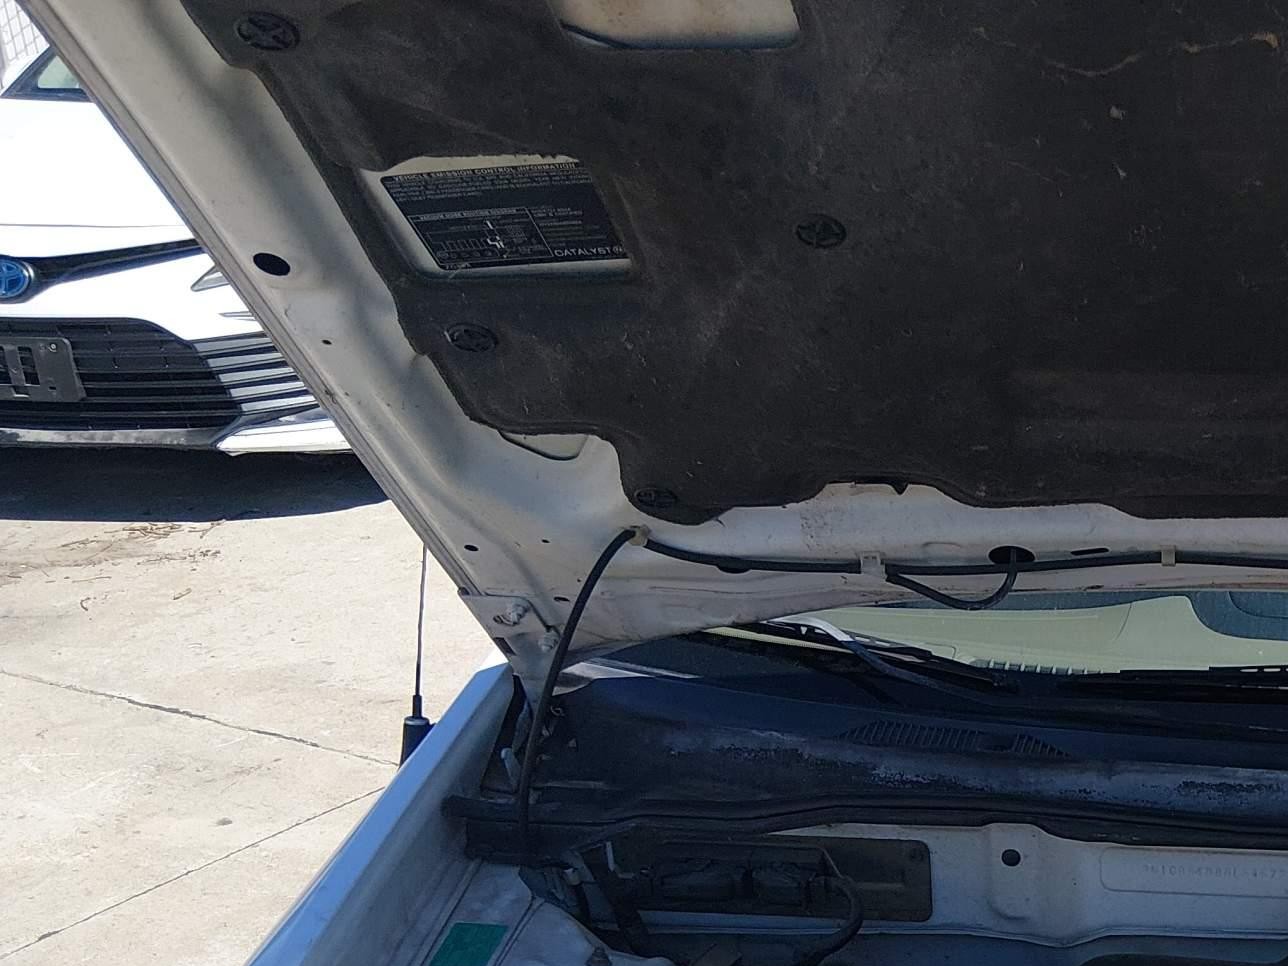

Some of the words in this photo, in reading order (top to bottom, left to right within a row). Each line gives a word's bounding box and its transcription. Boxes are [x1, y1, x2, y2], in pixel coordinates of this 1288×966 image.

[475, 167, 515, 175] CONTROL
[517, 163, 576, 172] INFORMATION
[554, 246, 612, 257] CATALYST
